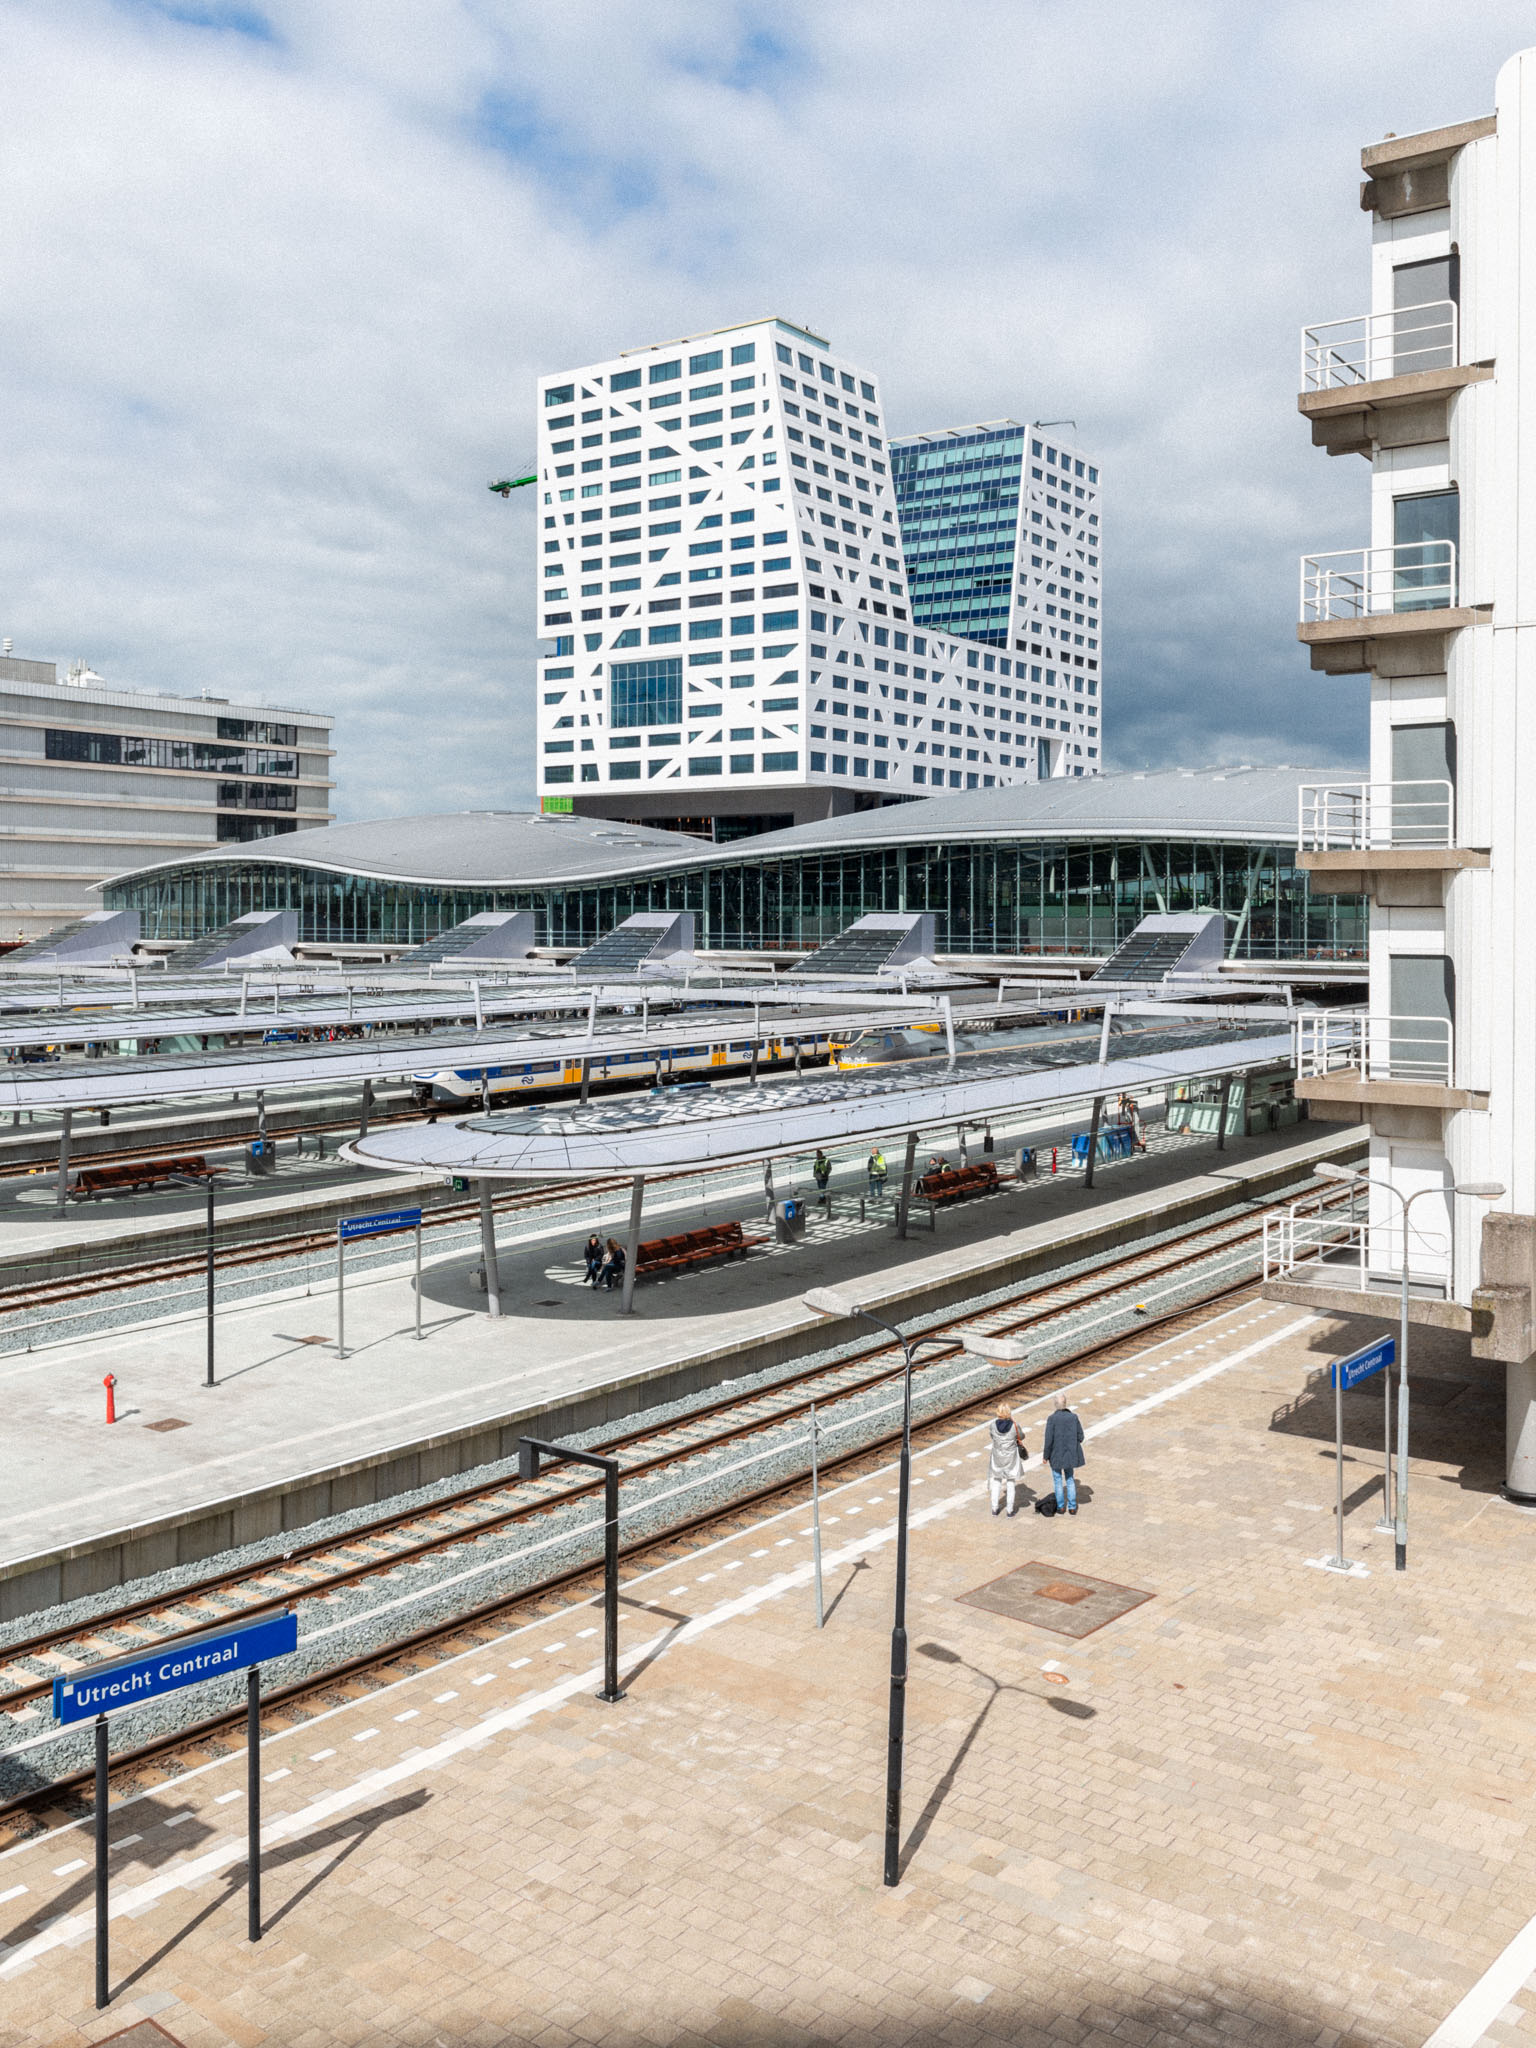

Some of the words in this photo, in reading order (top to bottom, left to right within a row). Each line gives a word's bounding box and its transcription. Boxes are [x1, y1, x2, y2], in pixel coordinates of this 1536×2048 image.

[347, 1221, 373, 1231] Utrecht
[76, 1671, 152, 1708] Utrecht
[158, 1641, 239, 1681] Centraal
